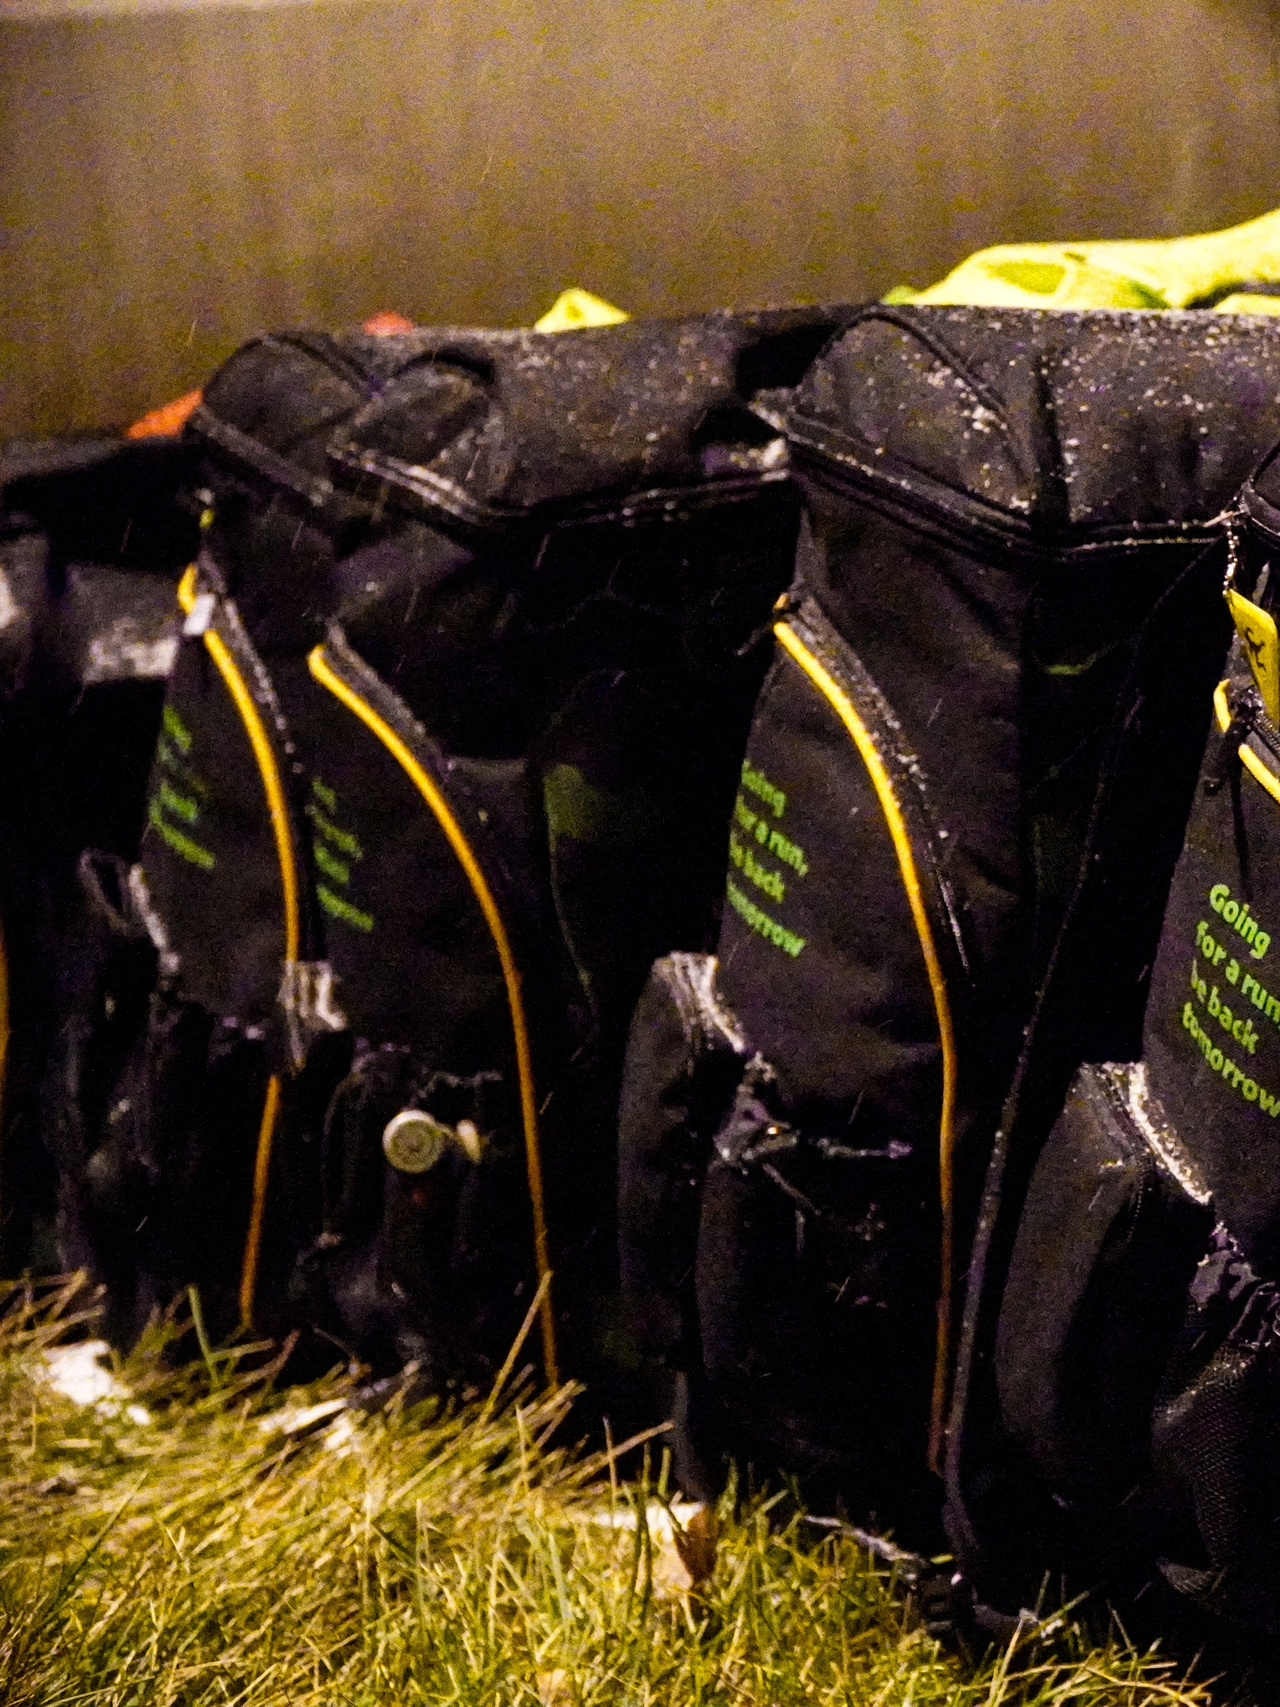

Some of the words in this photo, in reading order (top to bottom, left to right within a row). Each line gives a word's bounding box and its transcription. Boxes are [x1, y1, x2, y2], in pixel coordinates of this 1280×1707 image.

[1196, 921, 1226, 966] for
[1225, 959, 1239, 985] a
[1210, 884, 1271, 959] Going
[1207, 986, 1260, 1054] back
